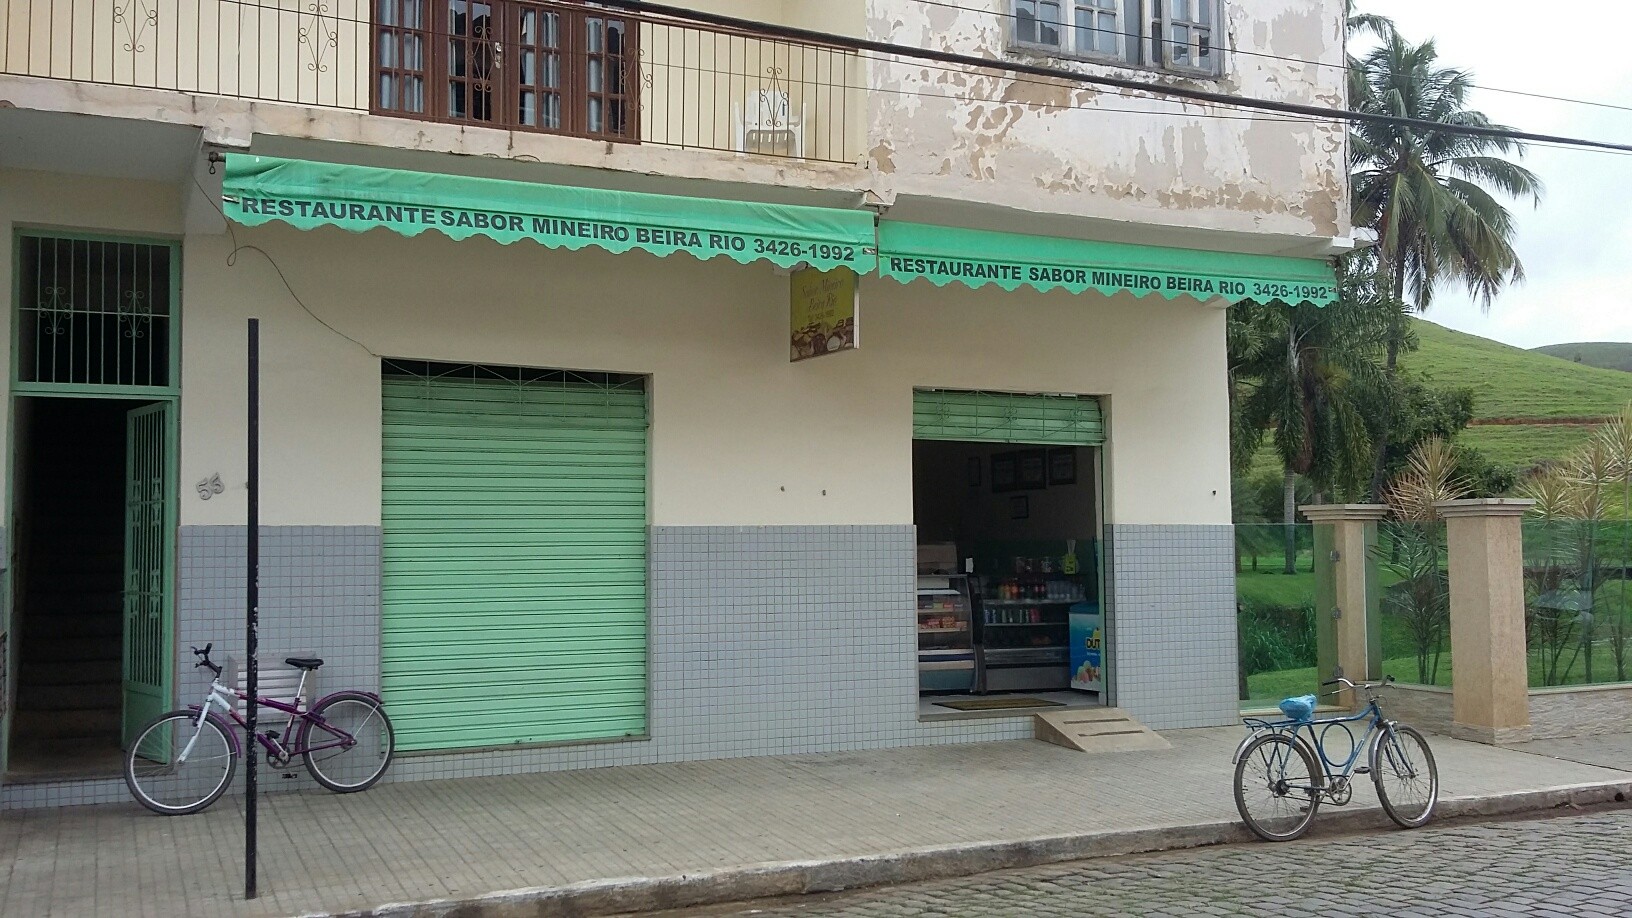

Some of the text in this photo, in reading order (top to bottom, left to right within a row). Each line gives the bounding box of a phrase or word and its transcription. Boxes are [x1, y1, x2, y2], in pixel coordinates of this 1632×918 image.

[242, 197, 855, 262] RESTAURANTE SABOR MINEIRO BEIRA RIO 3426-1992
[890, 256, 1328, 300] RESTAURANTE SABOR MINEIRO BEIRA RIO 3426-1992
